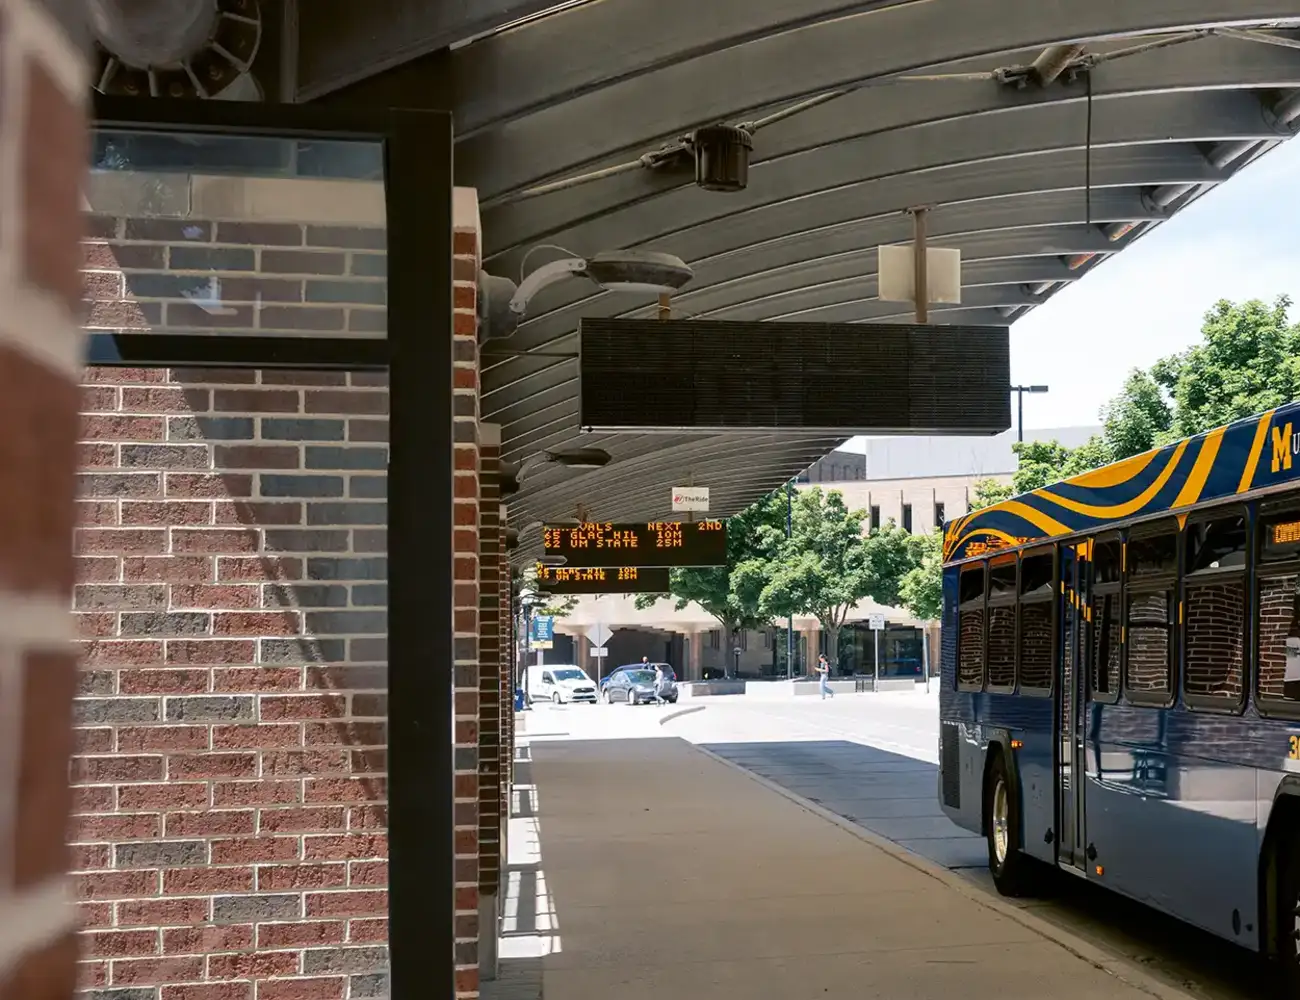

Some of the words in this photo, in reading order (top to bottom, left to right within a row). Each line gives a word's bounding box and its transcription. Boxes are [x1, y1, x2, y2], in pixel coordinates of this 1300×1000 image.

[1271, 422, 1293, 473] M
[648, 521, 681, 531] NEXT
[698, 521, 722, 531] 2ND
[544, 531, 560, 540] 65
[570, 531, 603, 540] GLAC
[614, 531, 638, 540] HIL
[657, 531, 682, 539] 10M
[544, 540, 560, 549] 62
[570, 539, 588, 548] UM
[597, 539, 638, 548] STATE
[657, 539, 682, 547] 25M
